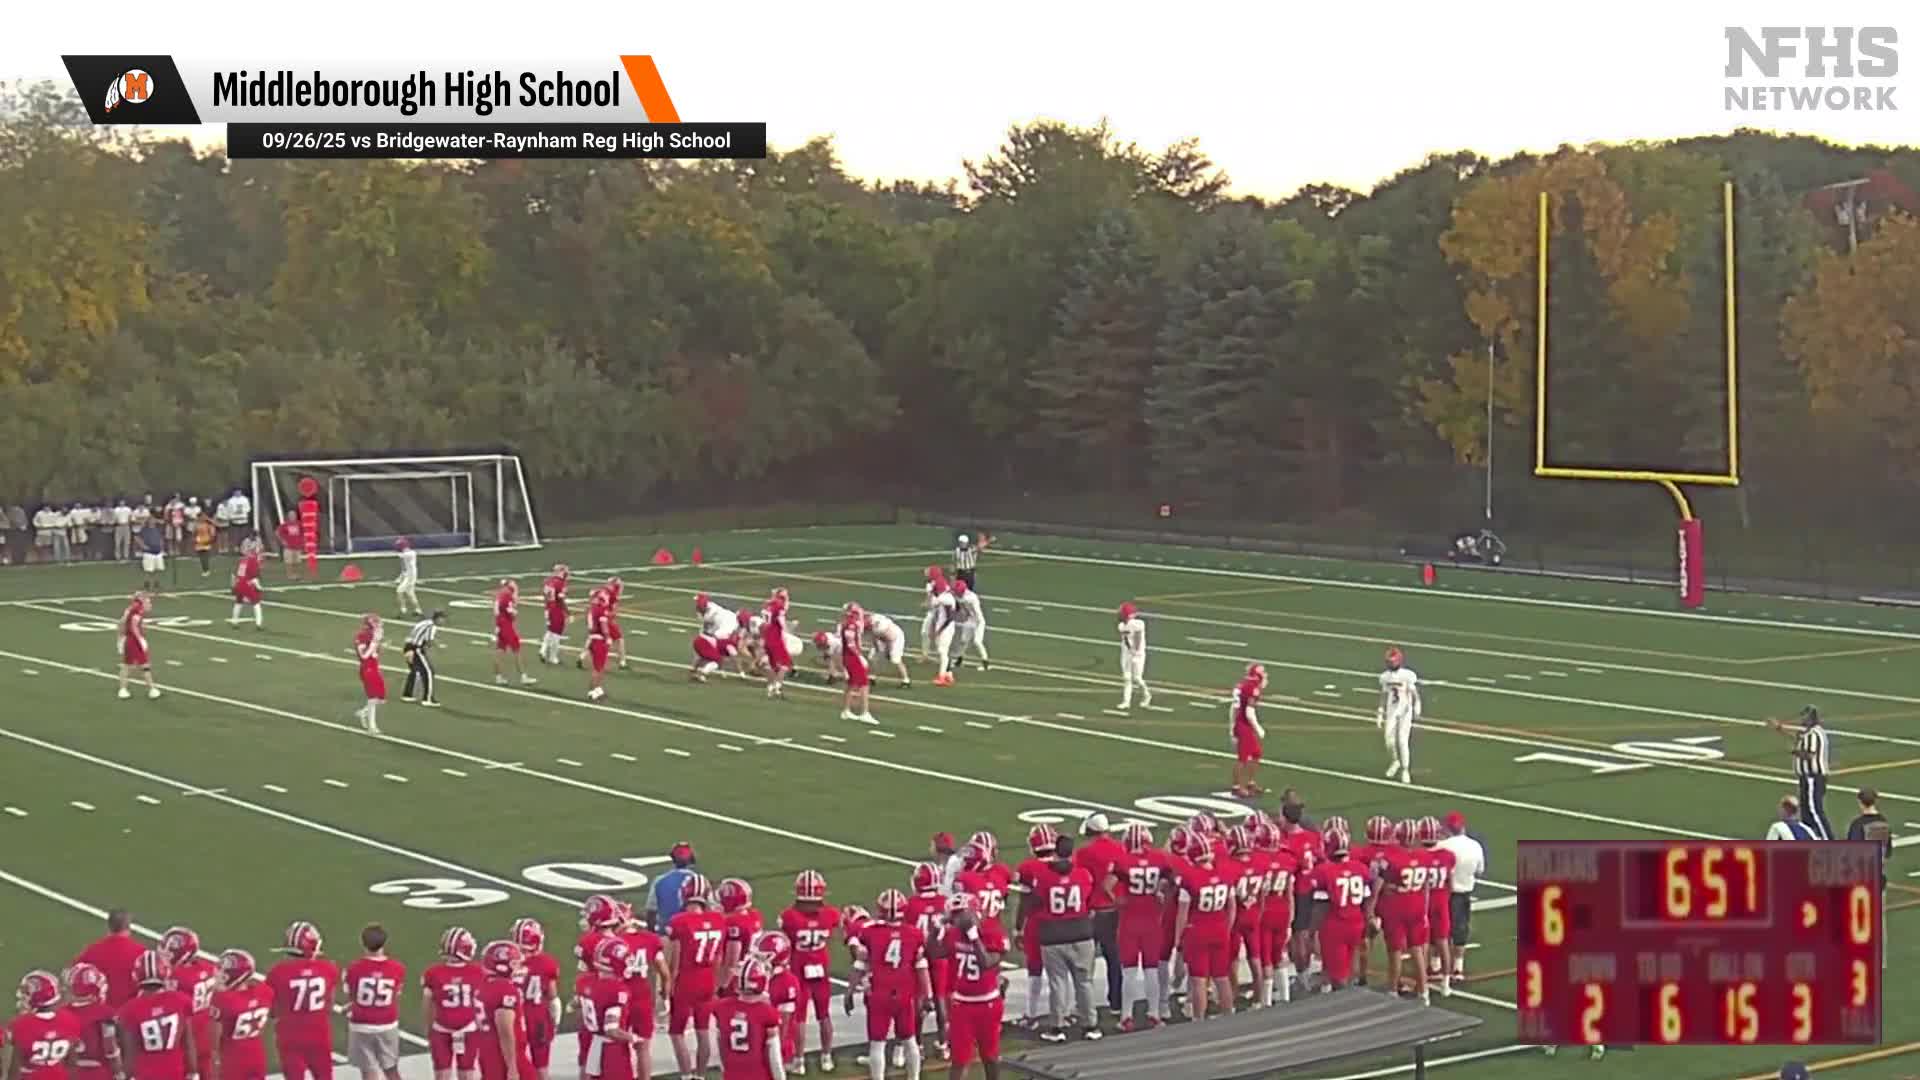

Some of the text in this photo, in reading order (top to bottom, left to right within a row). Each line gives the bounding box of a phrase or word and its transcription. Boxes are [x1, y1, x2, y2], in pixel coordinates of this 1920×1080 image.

[370, 863, 649, 908] 30
[1129, 866, 1161, 895] 59
[1199, 884, 1229, 913] 68
[1336, 875, 1364, 908] 79
[1049, 884, 1082, 915] 64
[1541, 885, 1565, 946] 6
[1850, 885, 1872, 944] 0
[693, 929, 723, 964] 77
[884, 938, 902, 969] 4
[954, 952, 981, 981] 75
[1526, 960, 1543, 1008] 3
[1852, 959, 1868, 1006] 3
[288, 976, 327, 1012] 72
[356, 976, 396, 1007] 65
[1582, 983, 1605, 1044] 2
[1659, 982, 1682, 1043] 6
[1726, 982, 1760, 1043] 15
[1793, 982, 1814, 1043] 3
[729, 1018, 750, 1052] 2
